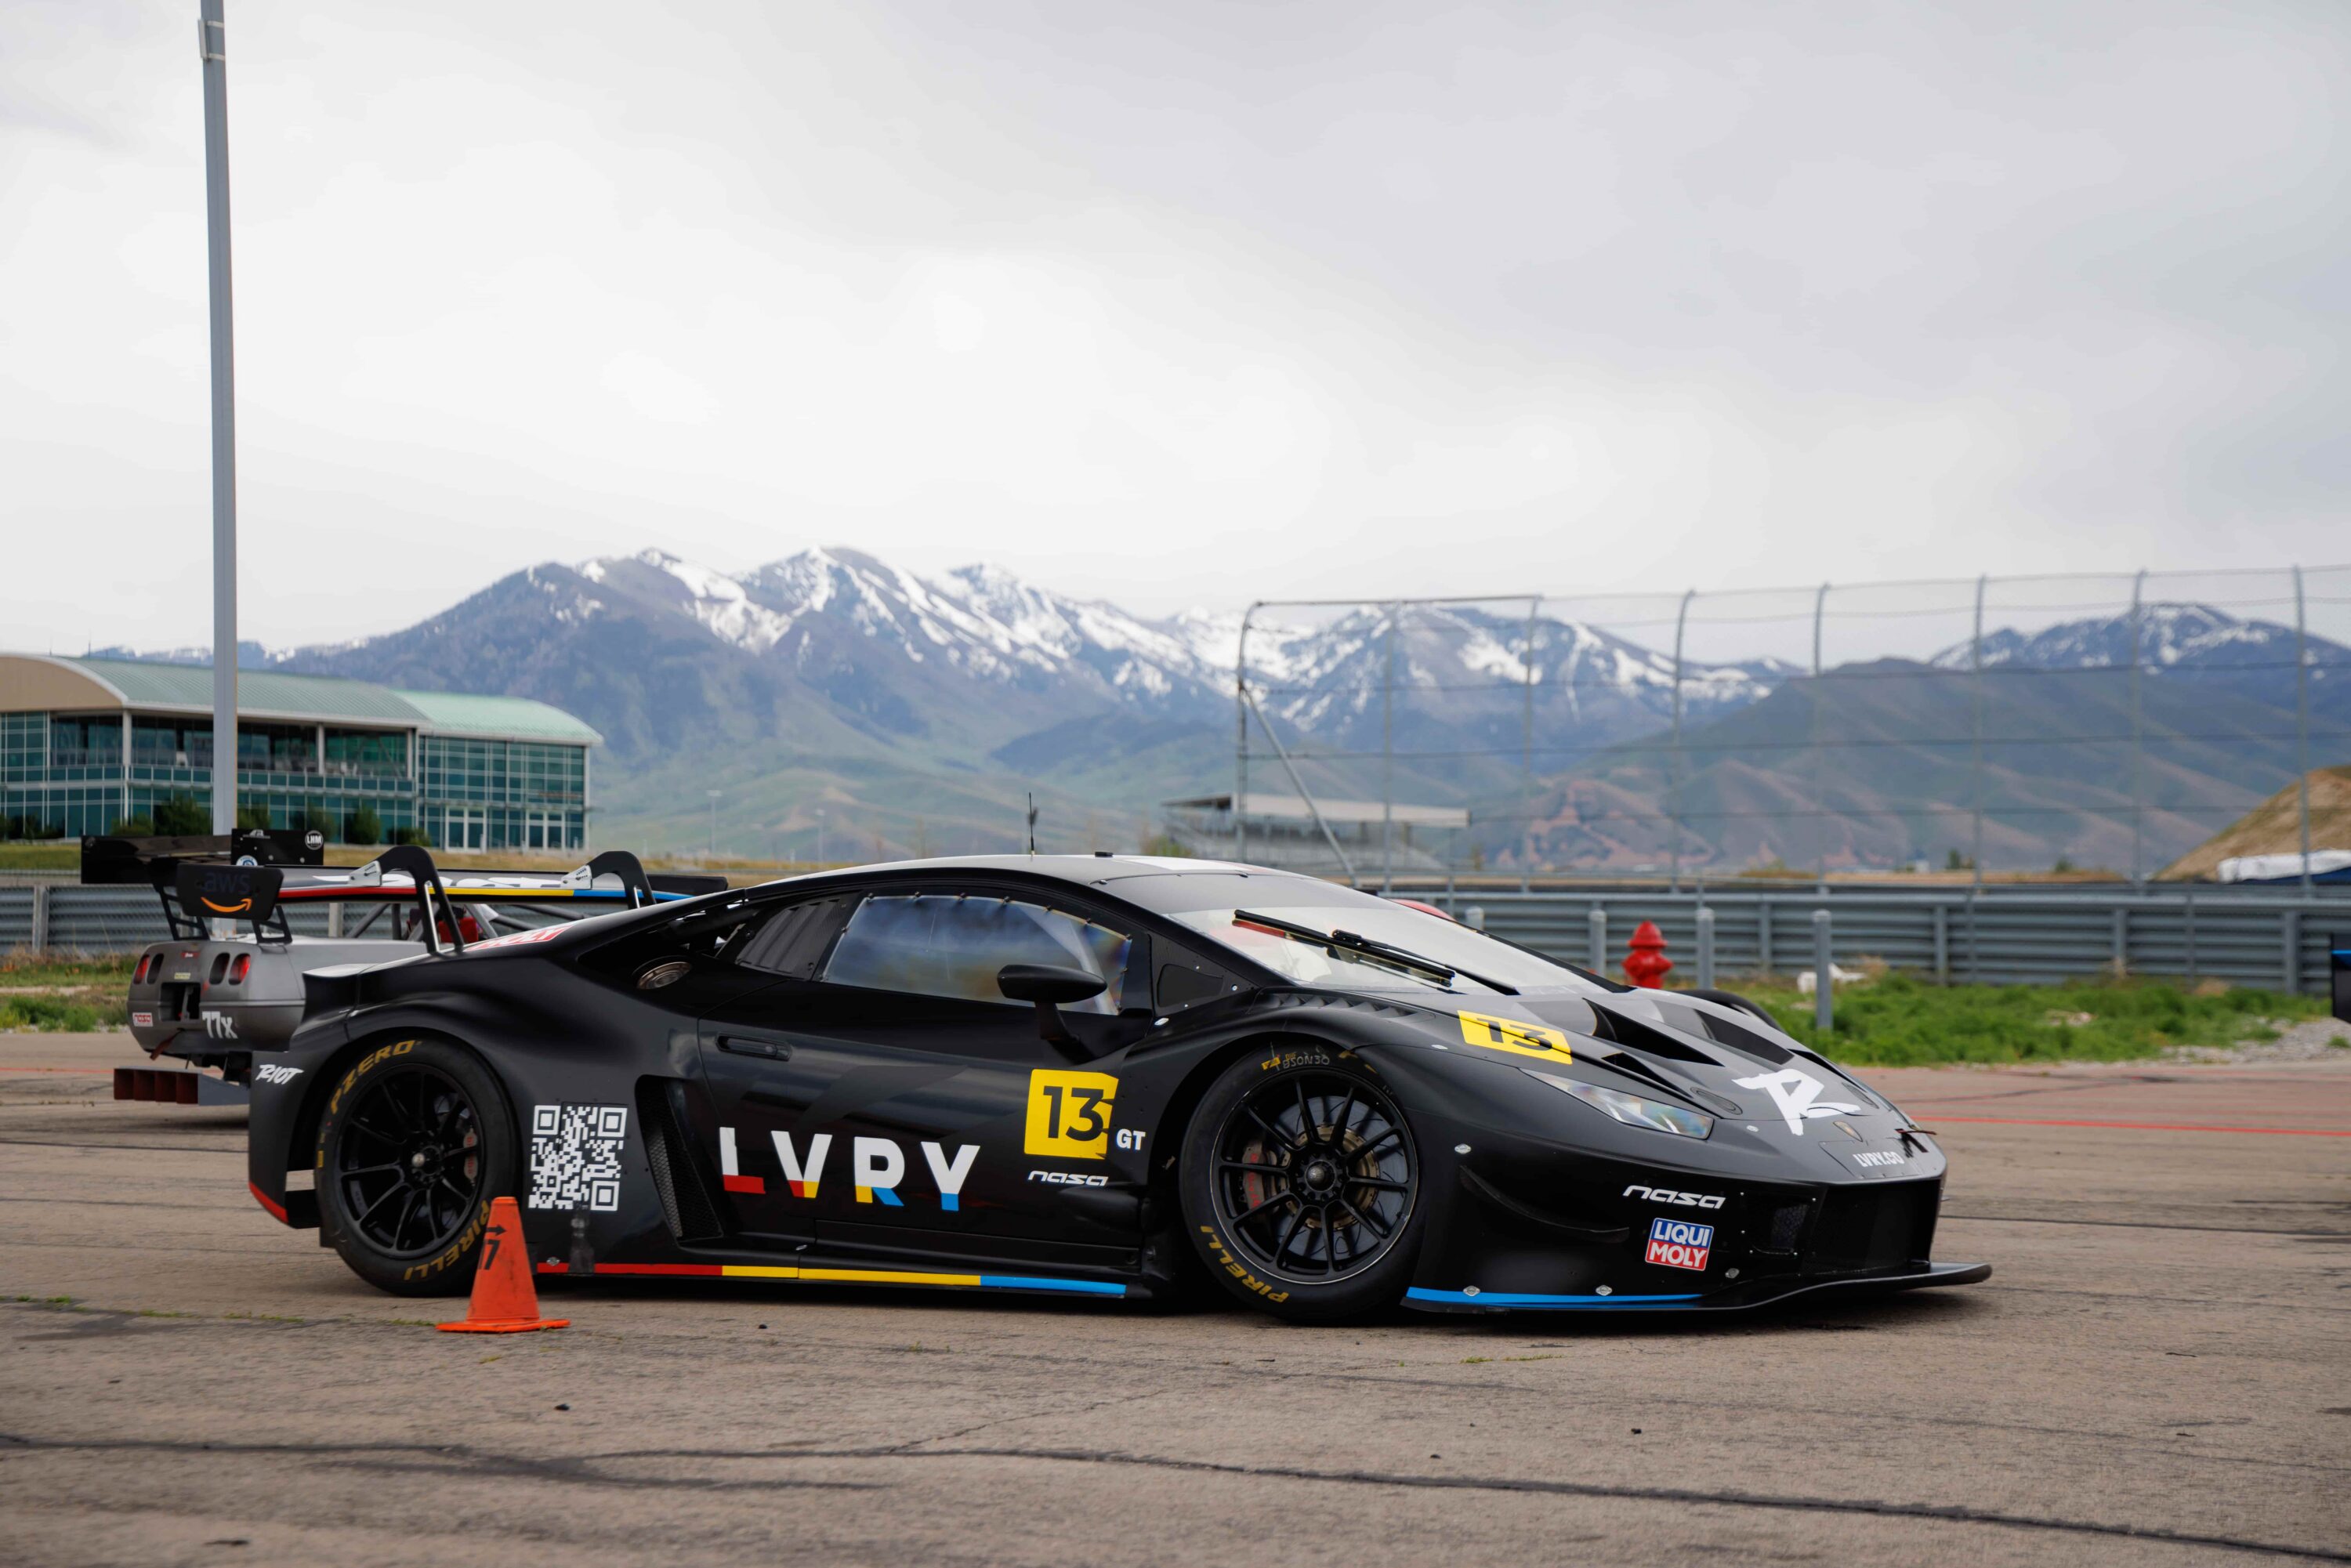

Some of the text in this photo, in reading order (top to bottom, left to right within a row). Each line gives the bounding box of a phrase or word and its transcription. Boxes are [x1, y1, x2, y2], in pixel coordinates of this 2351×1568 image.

[306, 835, 322, 845] LHM
[201, 871, 251, 894] aws
[1476, 1017, 1552, 1052] 13
[255, 1064, 304, 1085] RIOT
[1043, 1085, 1104, 1142] 13
[1116, 1128, 1146, 1150] GT
[719, 1126, 980, 1211] LVRY
[1852, 1151, 1905, 1168] LVRY.CO
[1027, 1170, 1109, 1186] nasa
[1622, 1185, 1726, 1209] nasa
[404, 1200, 491, 1280] PIRELLI
[1654, 1221, 1711, 1247] LIQUI
[1200, 1226, 1289, 1303] PIRELLI
[1649, 1242, 1708, 1267] MOLY
